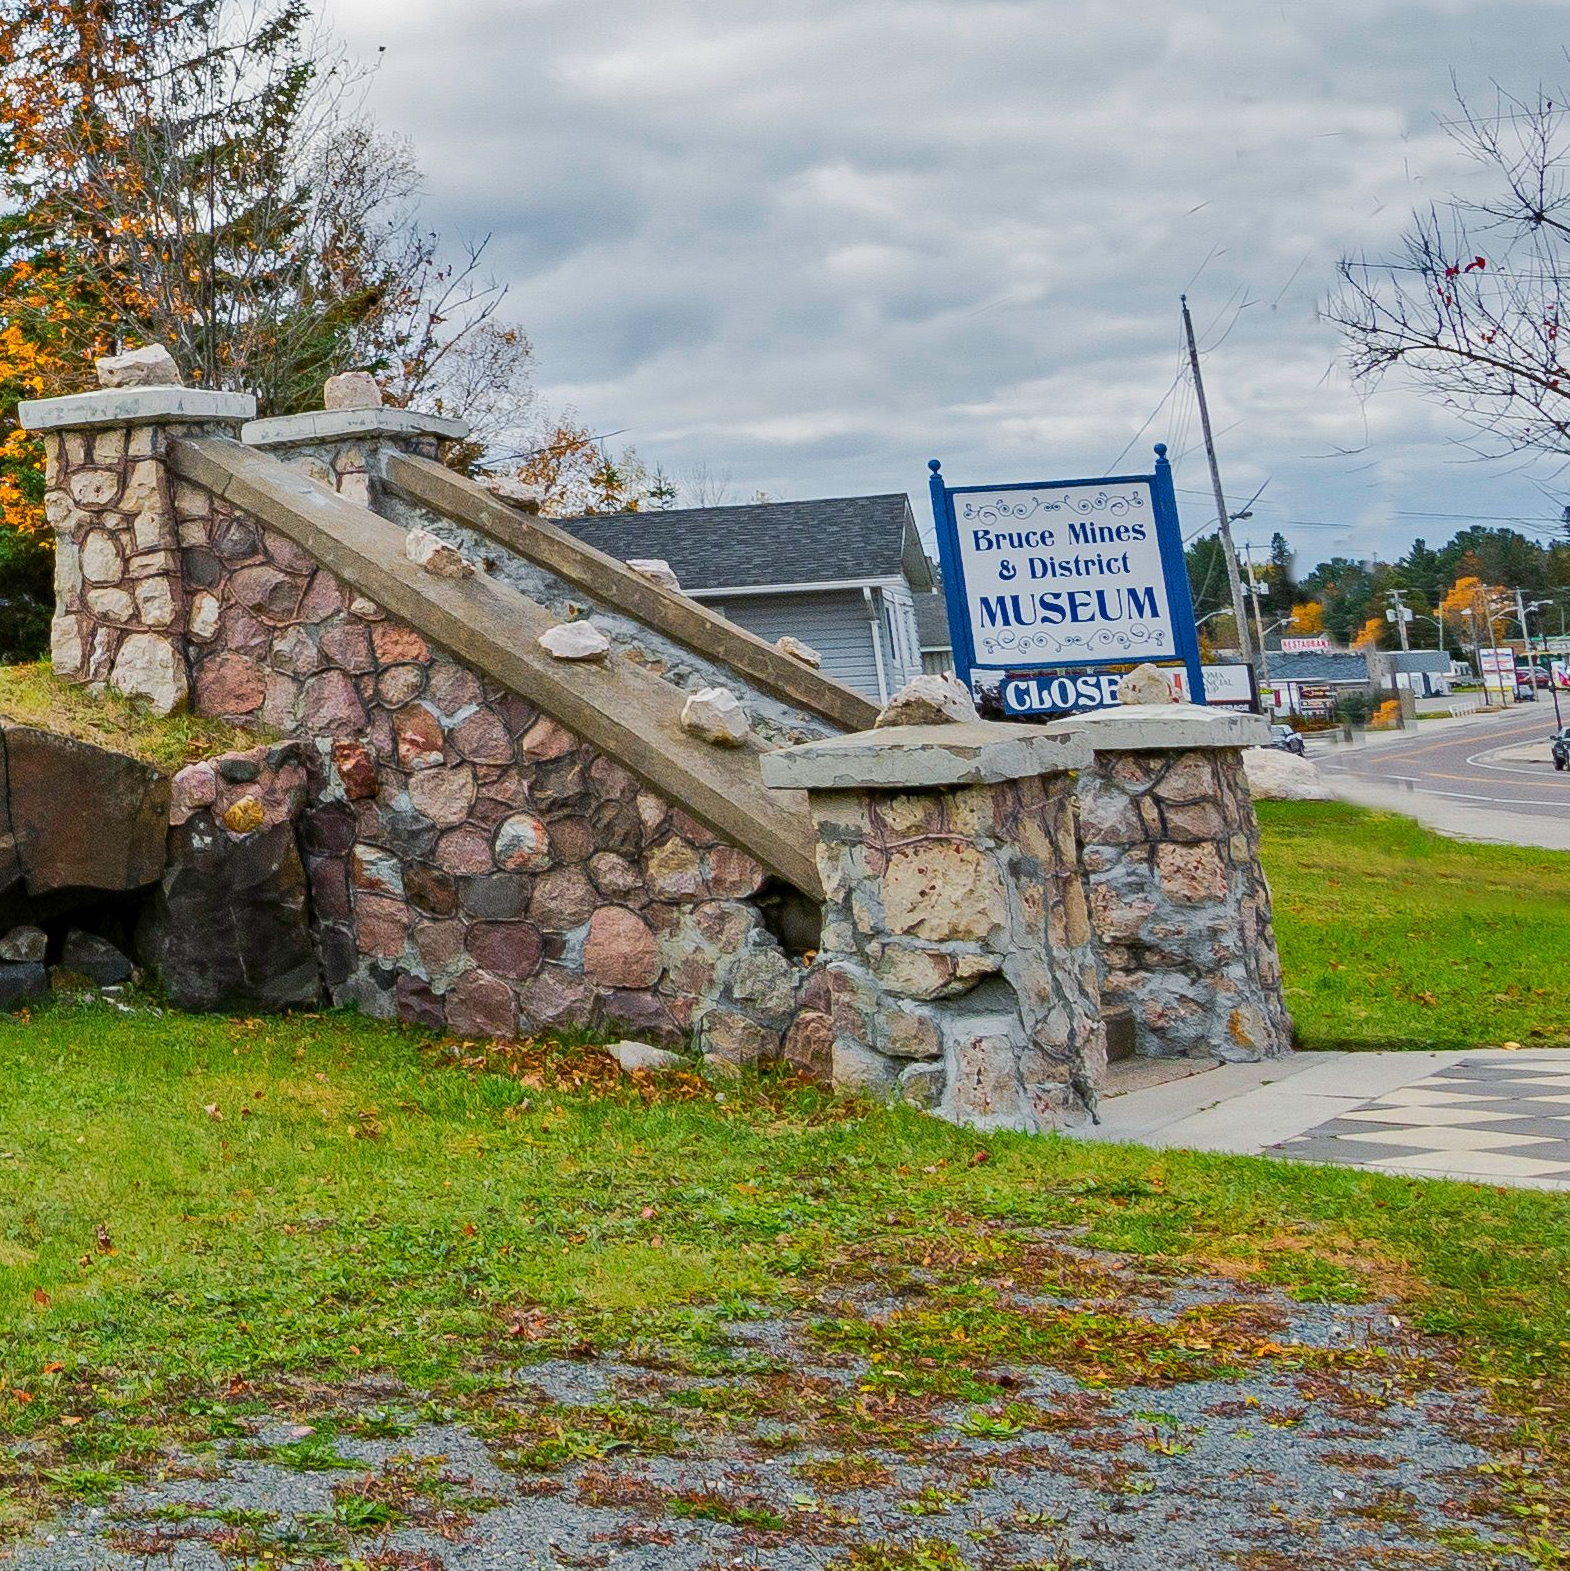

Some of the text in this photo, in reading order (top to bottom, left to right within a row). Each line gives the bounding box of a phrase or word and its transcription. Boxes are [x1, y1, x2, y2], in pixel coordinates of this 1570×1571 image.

[972, 521, 1147, 552] Bruce Mines
[998, 551, 1131, 581] & District
[979, 586, 1161, 628] MUSEUM
[1005, 675, 1125, 711] CLOSE
